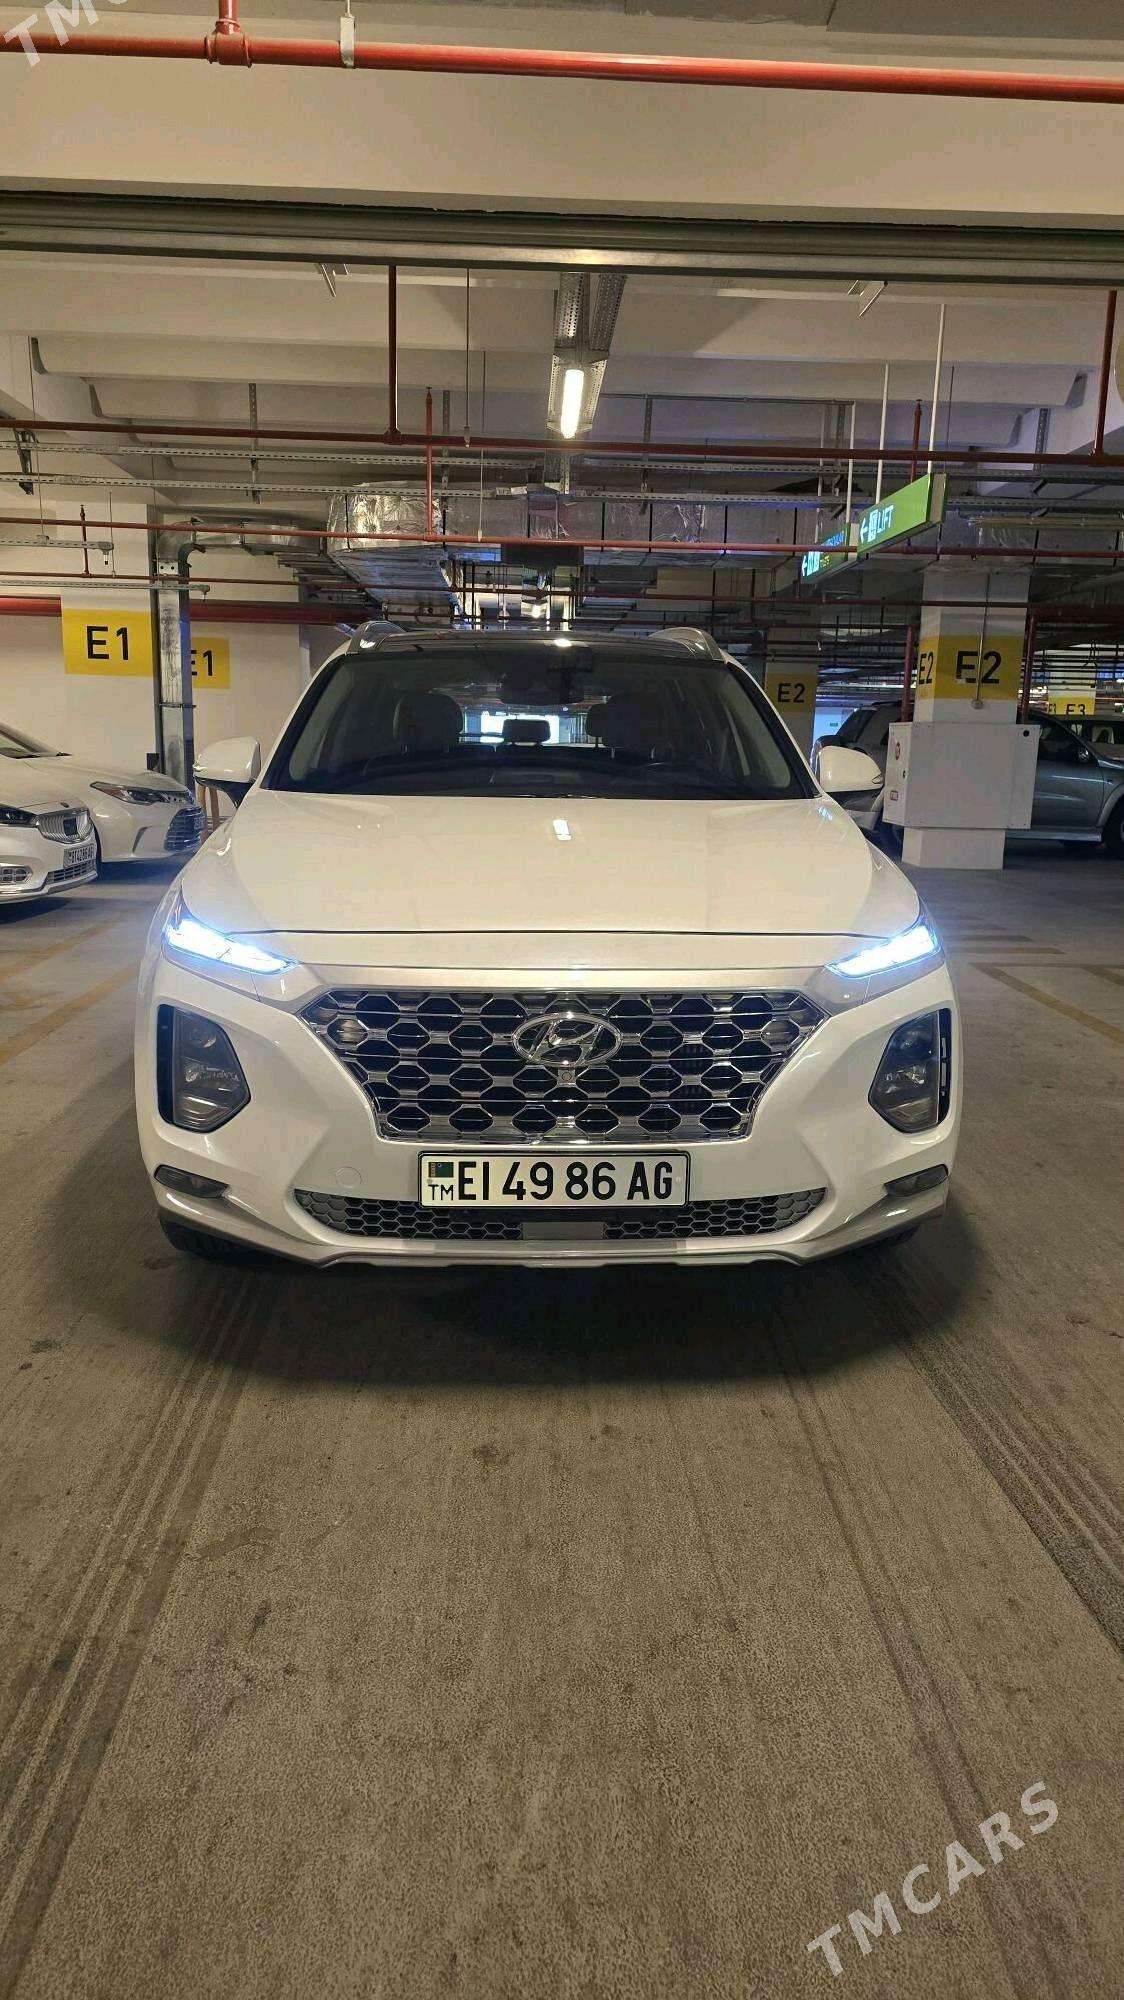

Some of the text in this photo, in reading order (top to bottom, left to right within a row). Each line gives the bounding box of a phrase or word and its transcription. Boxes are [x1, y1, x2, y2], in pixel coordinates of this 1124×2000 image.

[876, 505, 894, 534] LIFT
[86, 625, 129, 660] E1
[918, 651, 934, 685] E2
[955, 650, 1002, 684] E2
[777, 682, 806, 703] E2
[428, 1184, 454, 1201] TM
[458, 1161, 673, 1201] EI 49 86 AG
